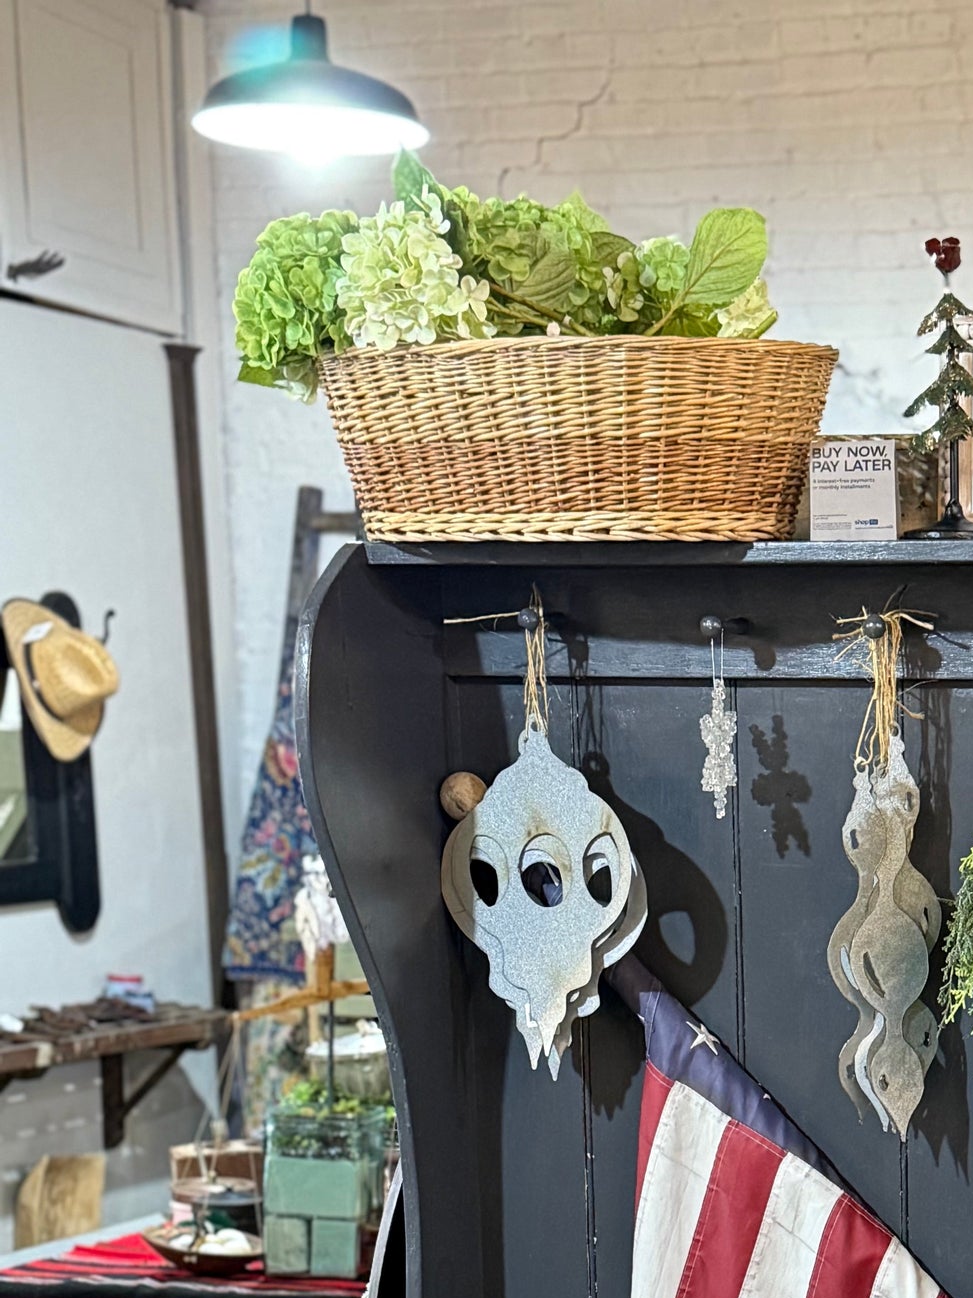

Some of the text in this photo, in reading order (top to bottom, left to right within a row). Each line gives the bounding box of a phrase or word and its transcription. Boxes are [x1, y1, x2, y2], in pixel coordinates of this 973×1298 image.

[812, 446, 888, 459] BUY NOW,
[812, 459, 891, 473] PAY LATER
